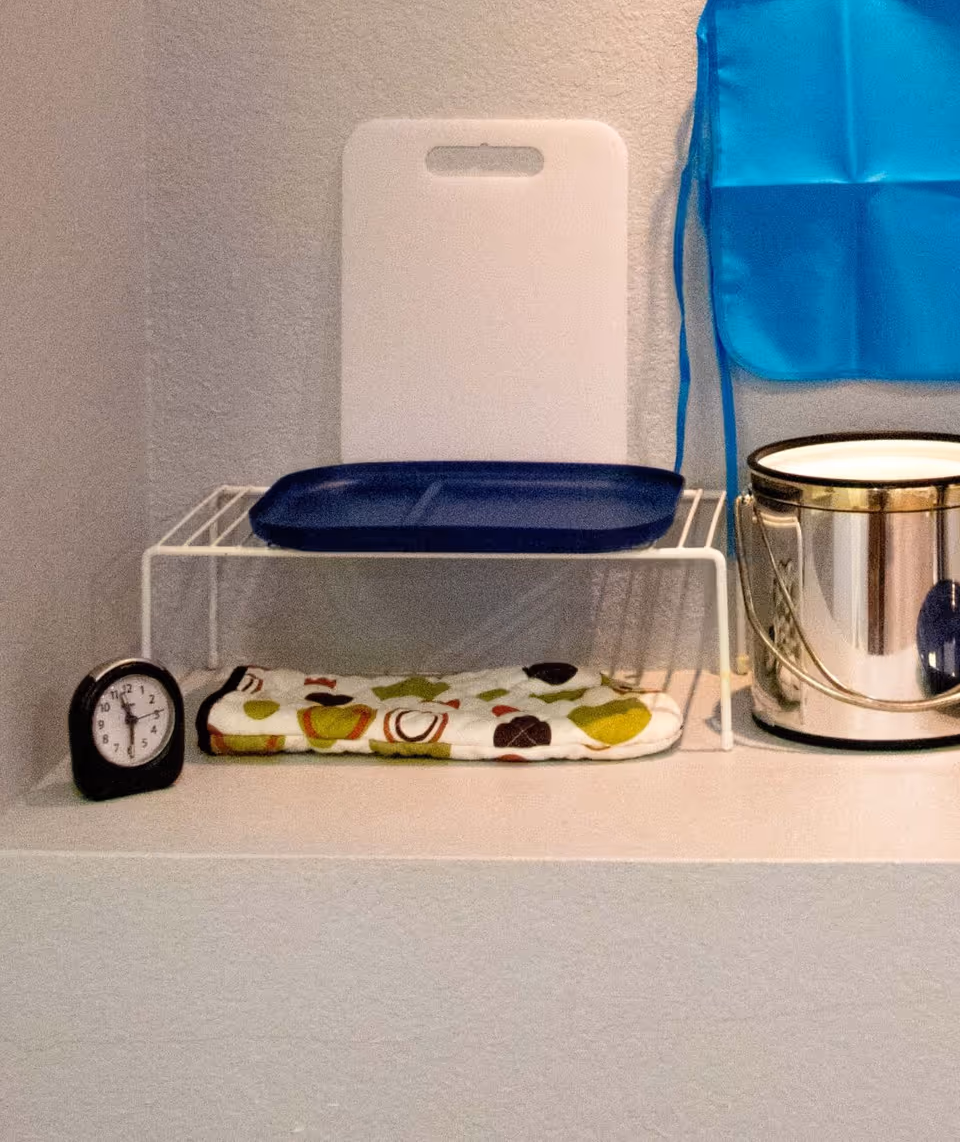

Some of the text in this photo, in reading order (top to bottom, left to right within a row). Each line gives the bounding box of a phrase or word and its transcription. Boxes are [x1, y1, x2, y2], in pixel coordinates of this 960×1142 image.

[122, 683, 132, 694] 12
[140, 686, 145, 695] 1
[110, 690, 119, 700] 11
[149, 694, 155, 704] 2
[99, 702, 111, 713] 10
[98, 720, 104, 730] 9
[150, 725, 157, 734] 4
[102, 734, 109, 744] 8
[142, 738, 148, 748] 5
[113, 743, 119, 753] 7
